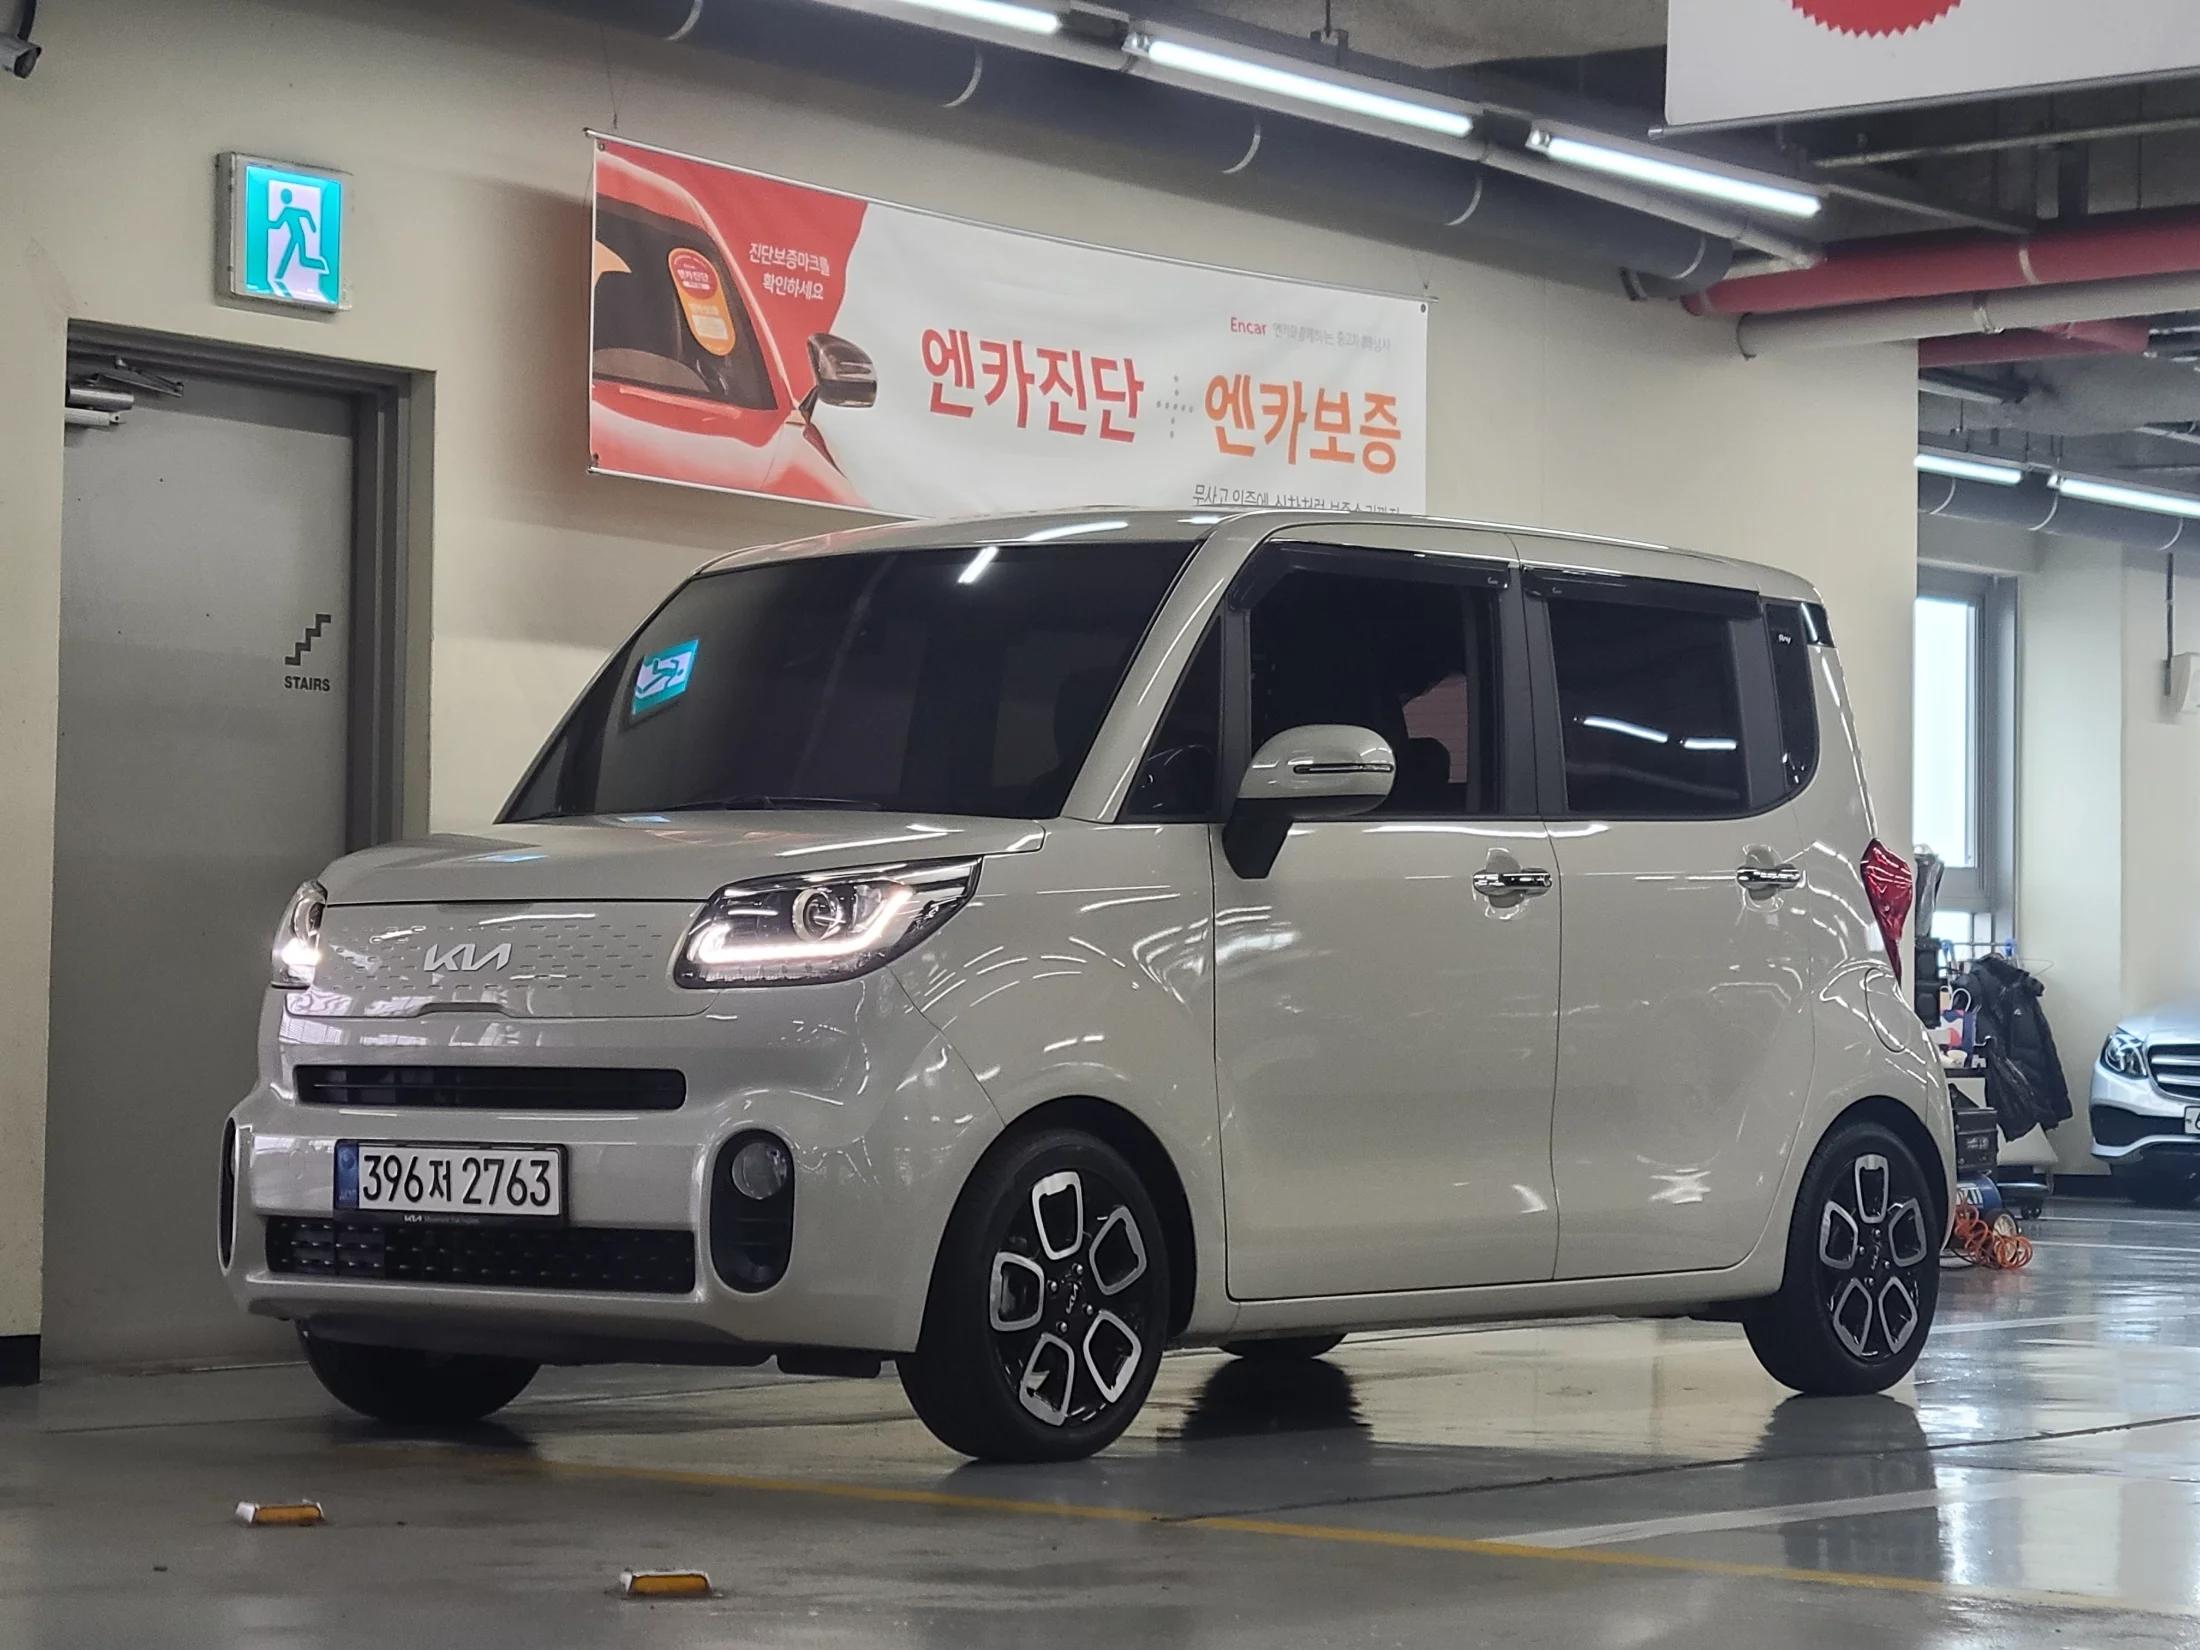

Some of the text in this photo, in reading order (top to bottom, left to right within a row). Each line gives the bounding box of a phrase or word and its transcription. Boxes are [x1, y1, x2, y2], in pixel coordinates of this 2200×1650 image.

[749, 243, 830, 276] 진단보증마크를
[762, 272, 824, 300] 확인하세요
[1230, 317, 1267, 336] Encar
[921, 328, 1402, 475] 엔카진단 엔카보증
[284, 675, 331, 692] STAIRS
[423, 943, 512, 971] KIA
[363, 1154, 550, 1207] 396저 2763
